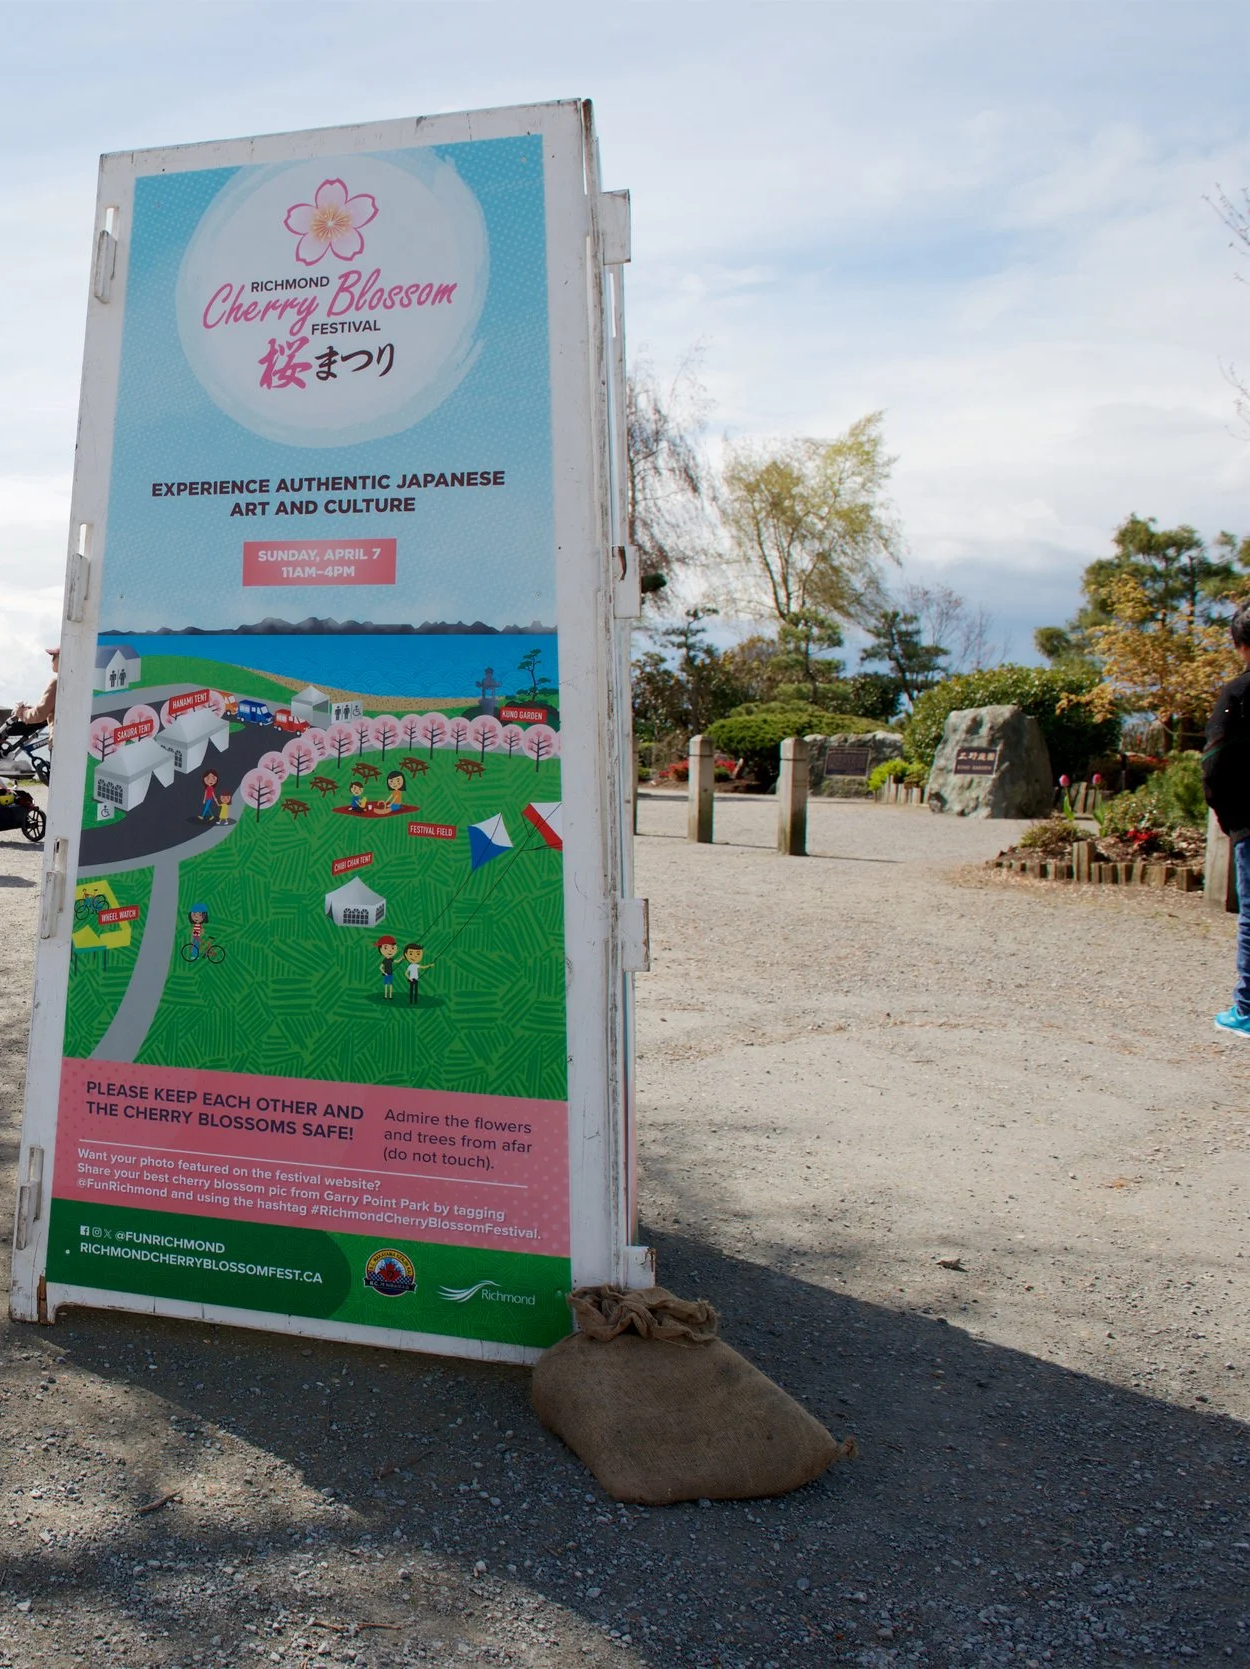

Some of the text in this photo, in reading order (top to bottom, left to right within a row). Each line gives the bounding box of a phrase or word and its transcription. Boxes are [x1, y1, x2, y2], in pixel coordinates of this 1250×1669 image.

[251, 276, 330, 293] RICHMOND
[202, 268, 458, 336] Cherry Blossom
[311, 320, 381, 335] FESTIVAL
[152, 470, 505, 497] EXPERIENCE AUTHENTIC JAPANESE
[230, 497, 416, 517] ART AND CULTURE
[258, 548, 381, 562] SUNDAY, APRIL 7
[172, 692, 207, 709] HANAMI TENT
[519, 711, 543, 720] GARDEN
[117, 723, 151, 740] SAKURA TENT
[410, 825, 453, 837] FESTIVAL FIELD
[360, 854, 371, 864] TENT
[86, 1081, 364, 1120] PLEASE KEEP EACH OTHER AND
[86, 1101, 353, 1140] THE CHERRY BLOSSOMS SAFE!
[384, 1108, 532, 1134] Admire the flowers
[384, 1130, 532, 1153] and trees from afar
[77, 1148, 381, 1191] Want your photo featured on the festival website?
[383, 1147, 494, 1171] (do not touch).
[77, 1163, 505, 1222] Share your best cherry blossom pic from Garry Point Park by tagging
[77, 1178, 542, 1239] @FunRichmond and using the hashtag #RichmondCherryBlossomFestival.
[115, 1230, 225, 1253] @FUNRICHMOND
[80, 1242, 323, 1284] RICHMONDCHERRYBLOSSOMFEST.CA
[481, 1288, 536, 1305] Richmond
